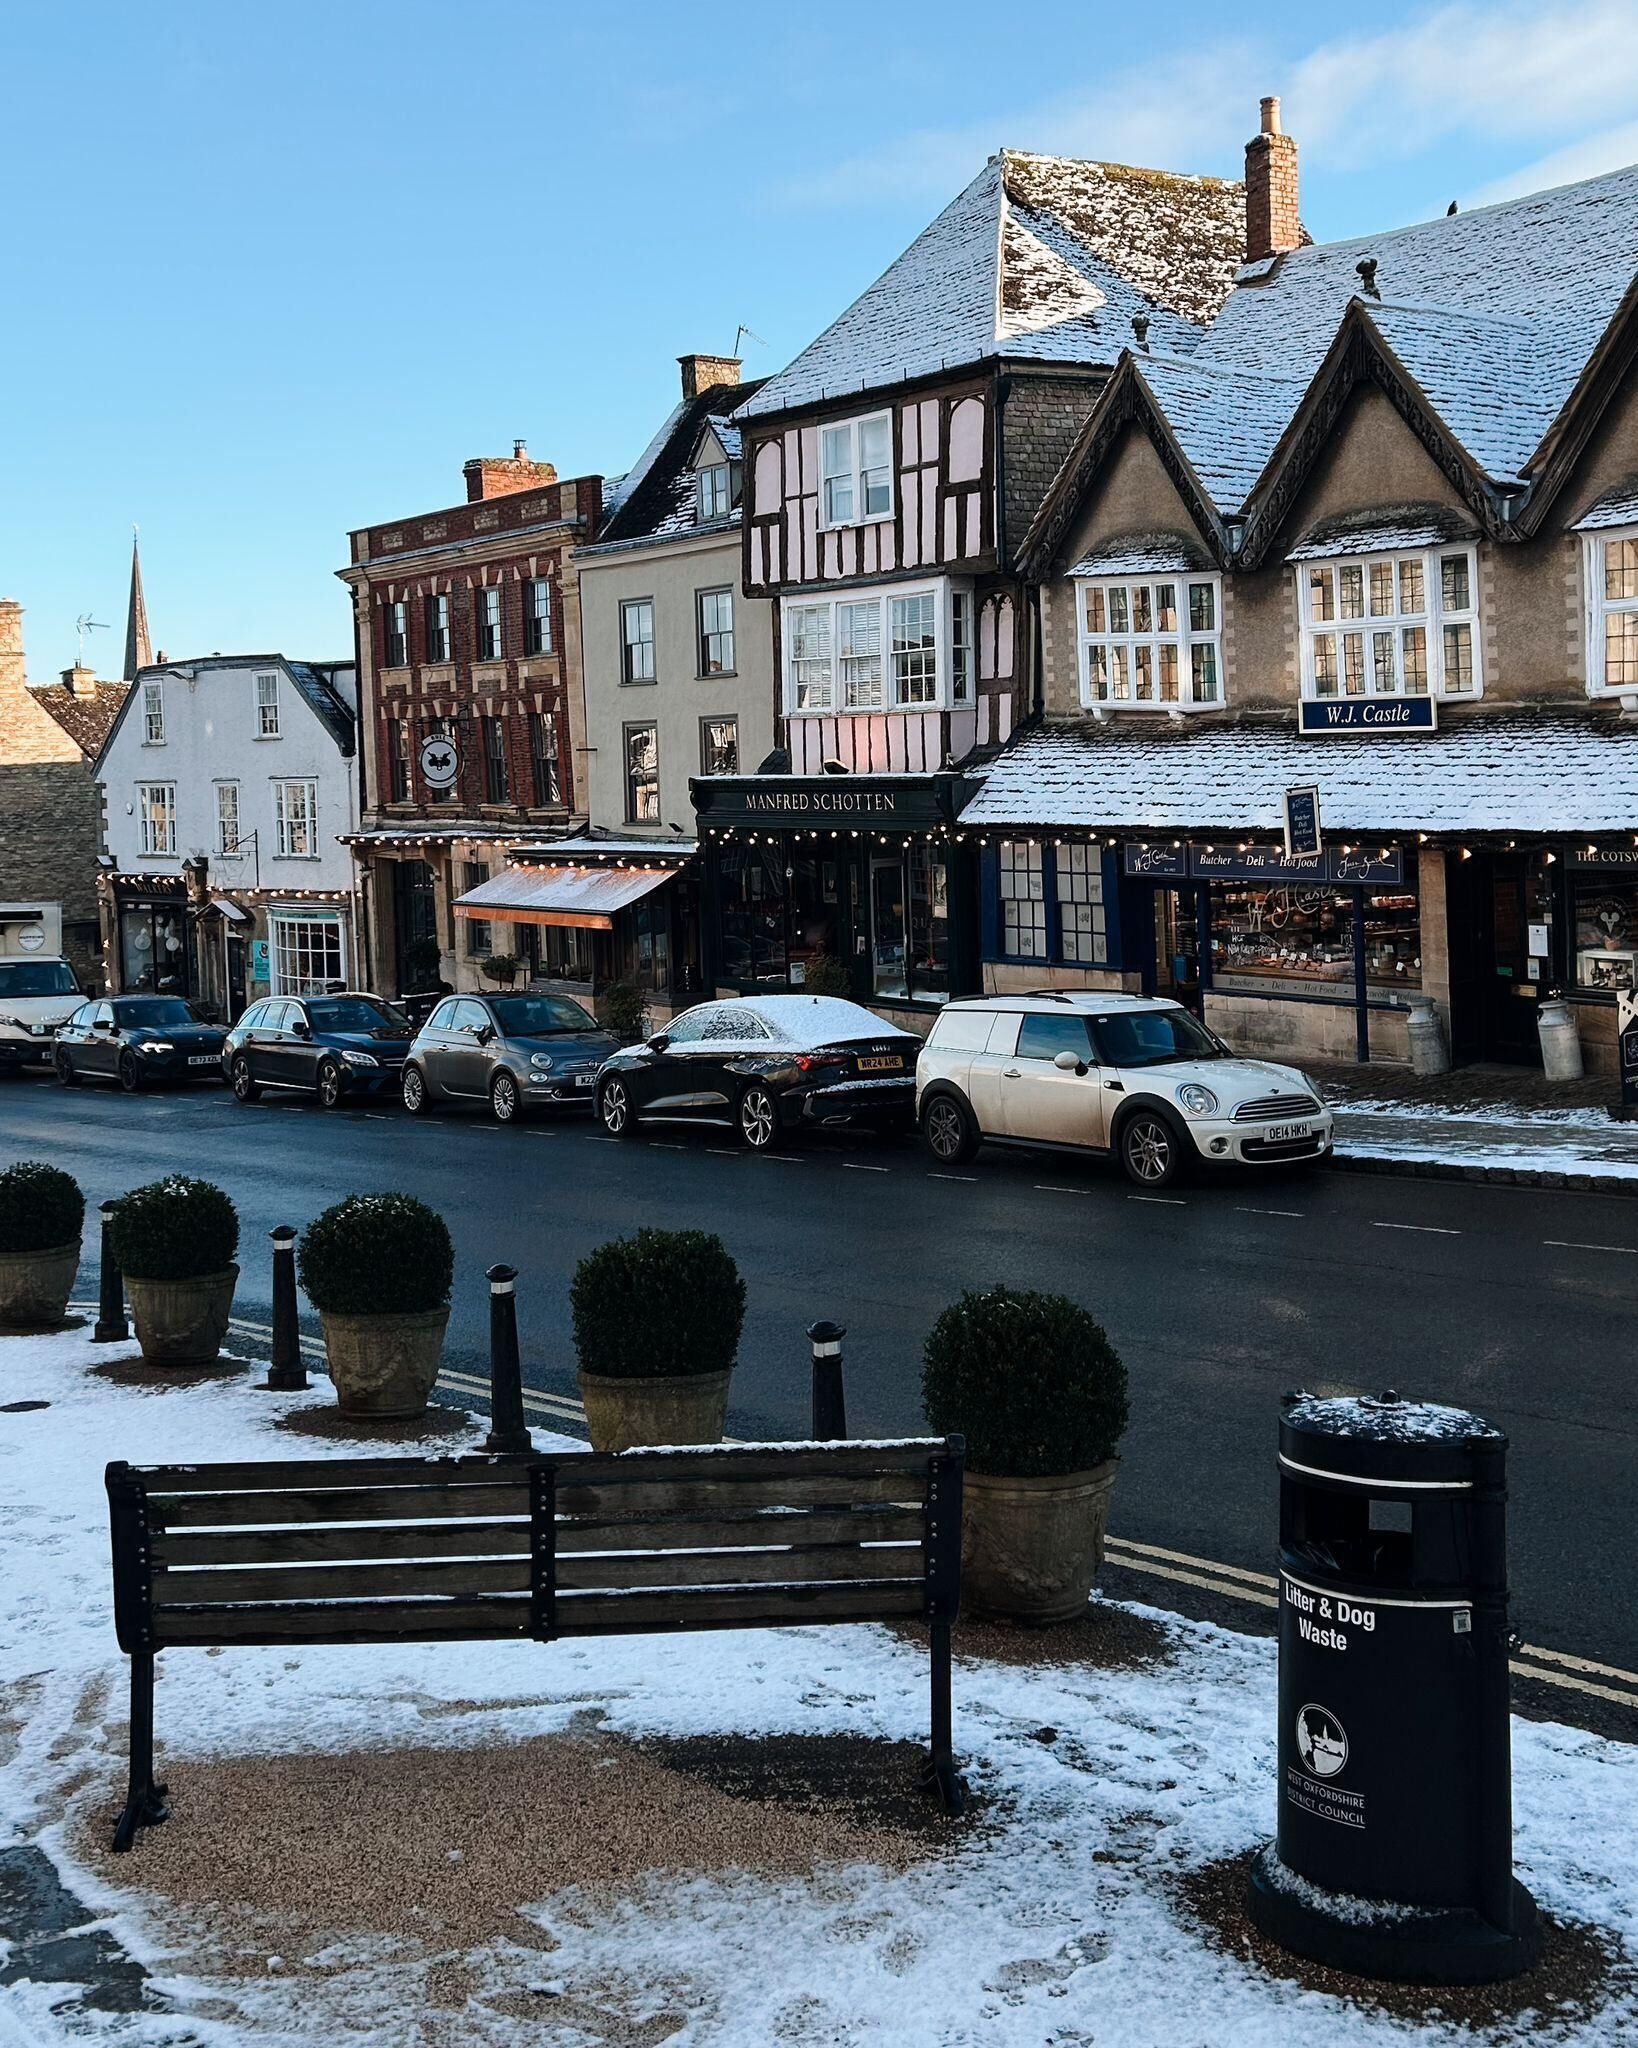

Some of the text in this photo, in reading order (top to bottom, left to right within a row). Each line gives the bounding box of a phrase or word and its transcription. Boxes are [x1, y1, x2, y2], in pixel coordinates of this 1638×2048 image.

[1327, 704, 1410, 723] W.J. Castle
[746, 793, 895, 811] MANFRED SCHOTTEN
[1200, 854, 1232, 865] Butcher
[1246, 855, 1264, 866] Deli
[1279, 856, 1295, 868] Hot
[1576, 850, 1599, 862] THE
[1319, 983, 1337, 994] Food
[1270, 1127, 1289, 1139] OE14
[1285, 1581, 1375, 1632] Litter & Dog
[1299, 1617, 1347, 1651] Waste
[1303, 1781, 1365, 1808] OXFORDSHIRE
[1318, 1803, 1365, 1824] COUNCIL
